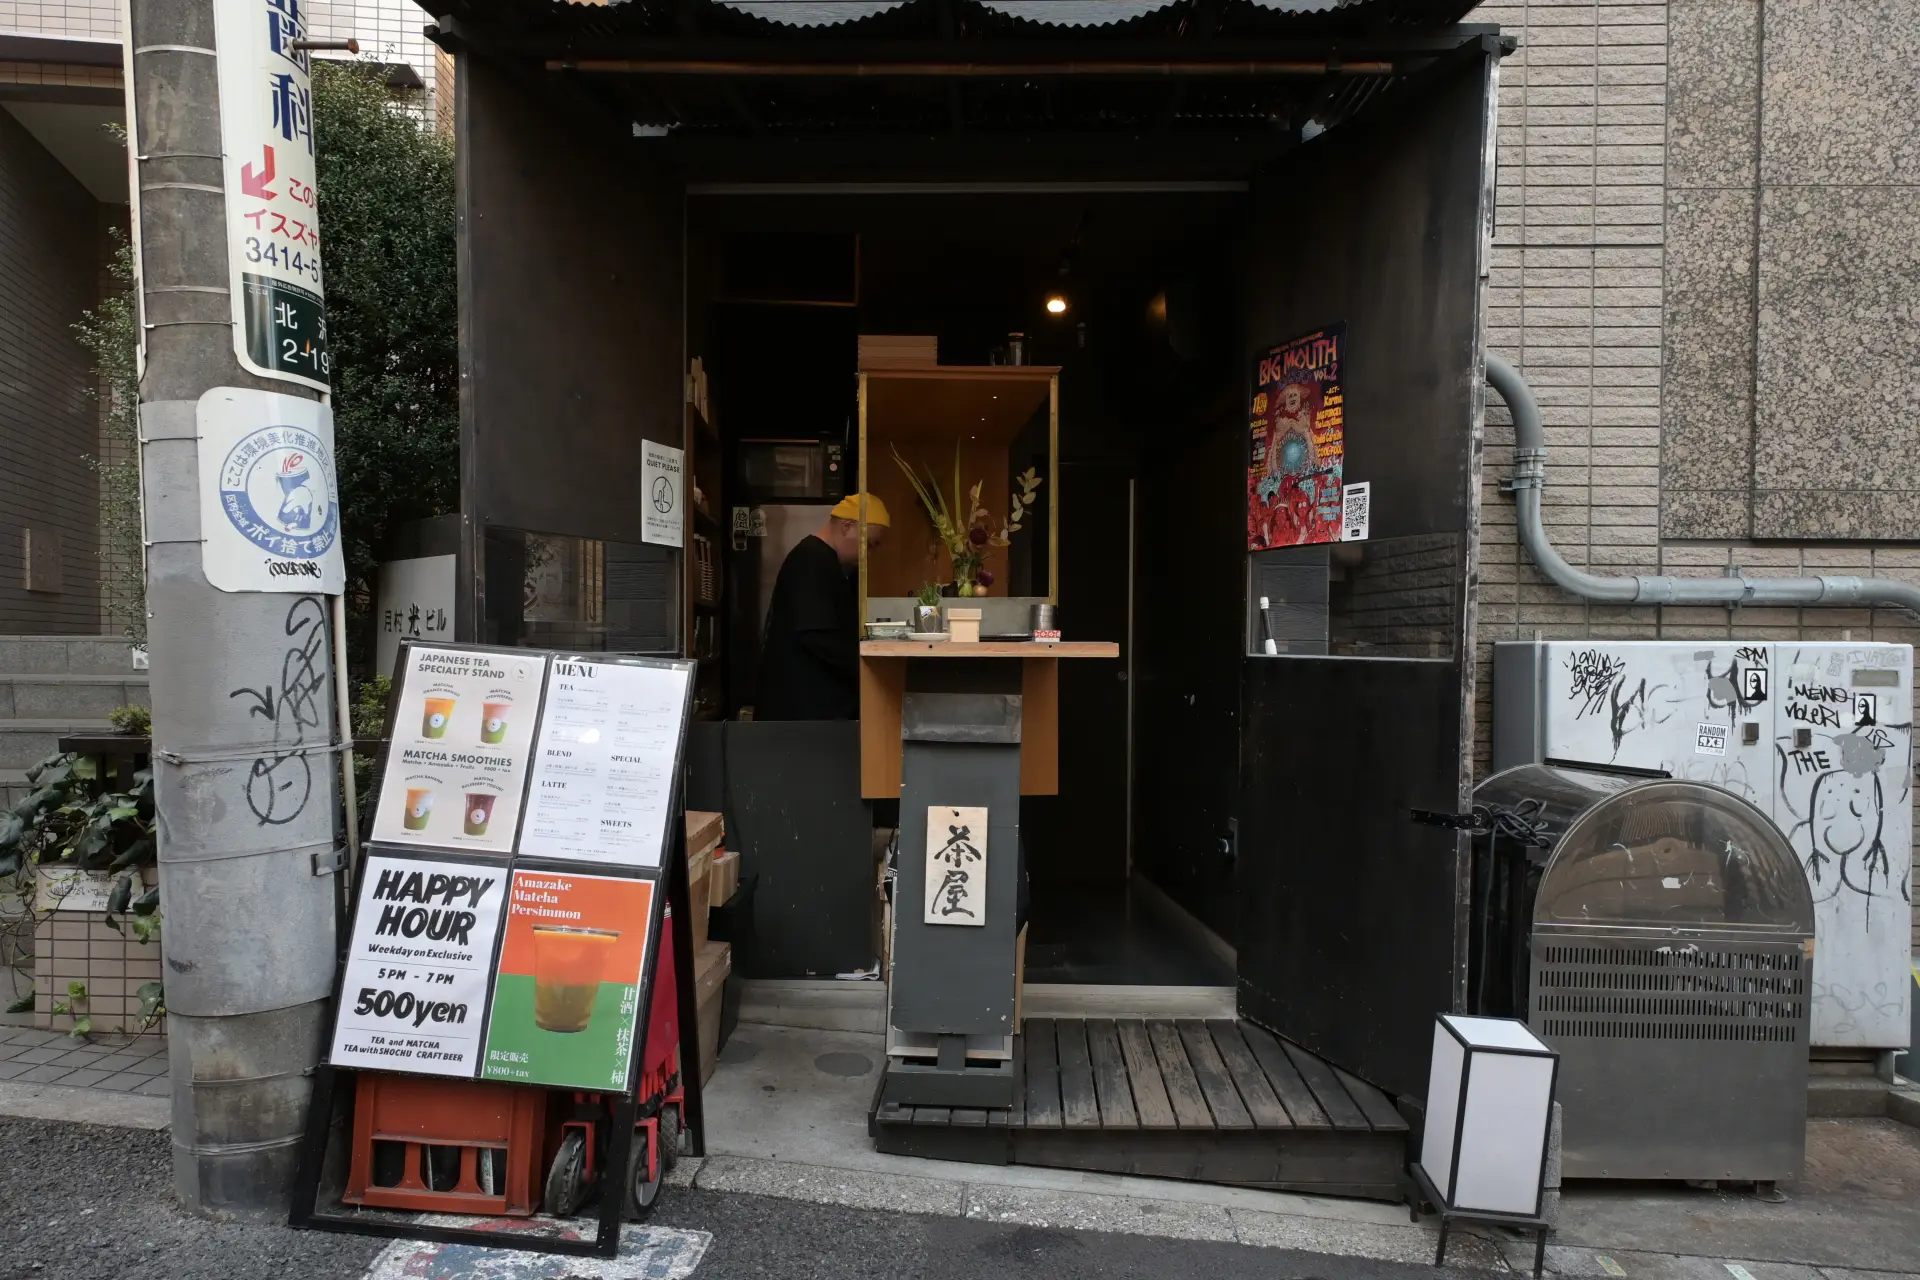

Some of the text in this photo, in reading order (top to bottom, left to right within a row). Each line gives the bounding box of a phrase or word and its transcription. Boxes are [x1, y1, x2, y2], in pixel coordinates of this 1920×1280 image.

[283, 338, 329, 373] 2-19
[1259, 356, 1280, 386] BIG
[1284, 336, 1338, 376] MOUTH
[282, 452, 303, 473] NO
[646, 459, 680, 474] QUIET PLEASE
[247, 523, 332, 555] ポイ捨て禁止
[420, 654, 490, 668] JAPANESE TEA
[418, 664, 470, 676] SPECIALTY
[472, 668, 505, 679] STAND
[554, 664, 598, 678] MENU
[560, 683, 574, 691] TEA
[1699, 725, 1726, 736] RANDOM
[403, 750, 512, 767] MATCHA SMOOTHIES
[547, 750, 572, 758] BLEND
[610, 755, 642, 764] SPECIAL
[1788, 750, 1830, 775] THE
[542, 780, 568, 789] LATTE
[600, 820, 632, 828] SWEETS
[931, 824, 982, 918] 茶屋
[372, 868, 496, 908] HAPPY
[514, 876, 572, 891] Amazake
[513, 890, 558, 904] Matcha
[512, 904, 581, 920] Persimmon
[375, 904, 476, 946] HOUR
[368, 944, 473, 962] Weekday on Exclusive
[354, 988, 468, 1028] 500yen
[371, 1036, 385, 1044] TEA
[406, 1040, 440, 1050] MATCHA
[344, 1044, 464, 1062] TEA with SHOCHU CRAFT BEER
[490, 1050, 529, 1063] 限定販売
